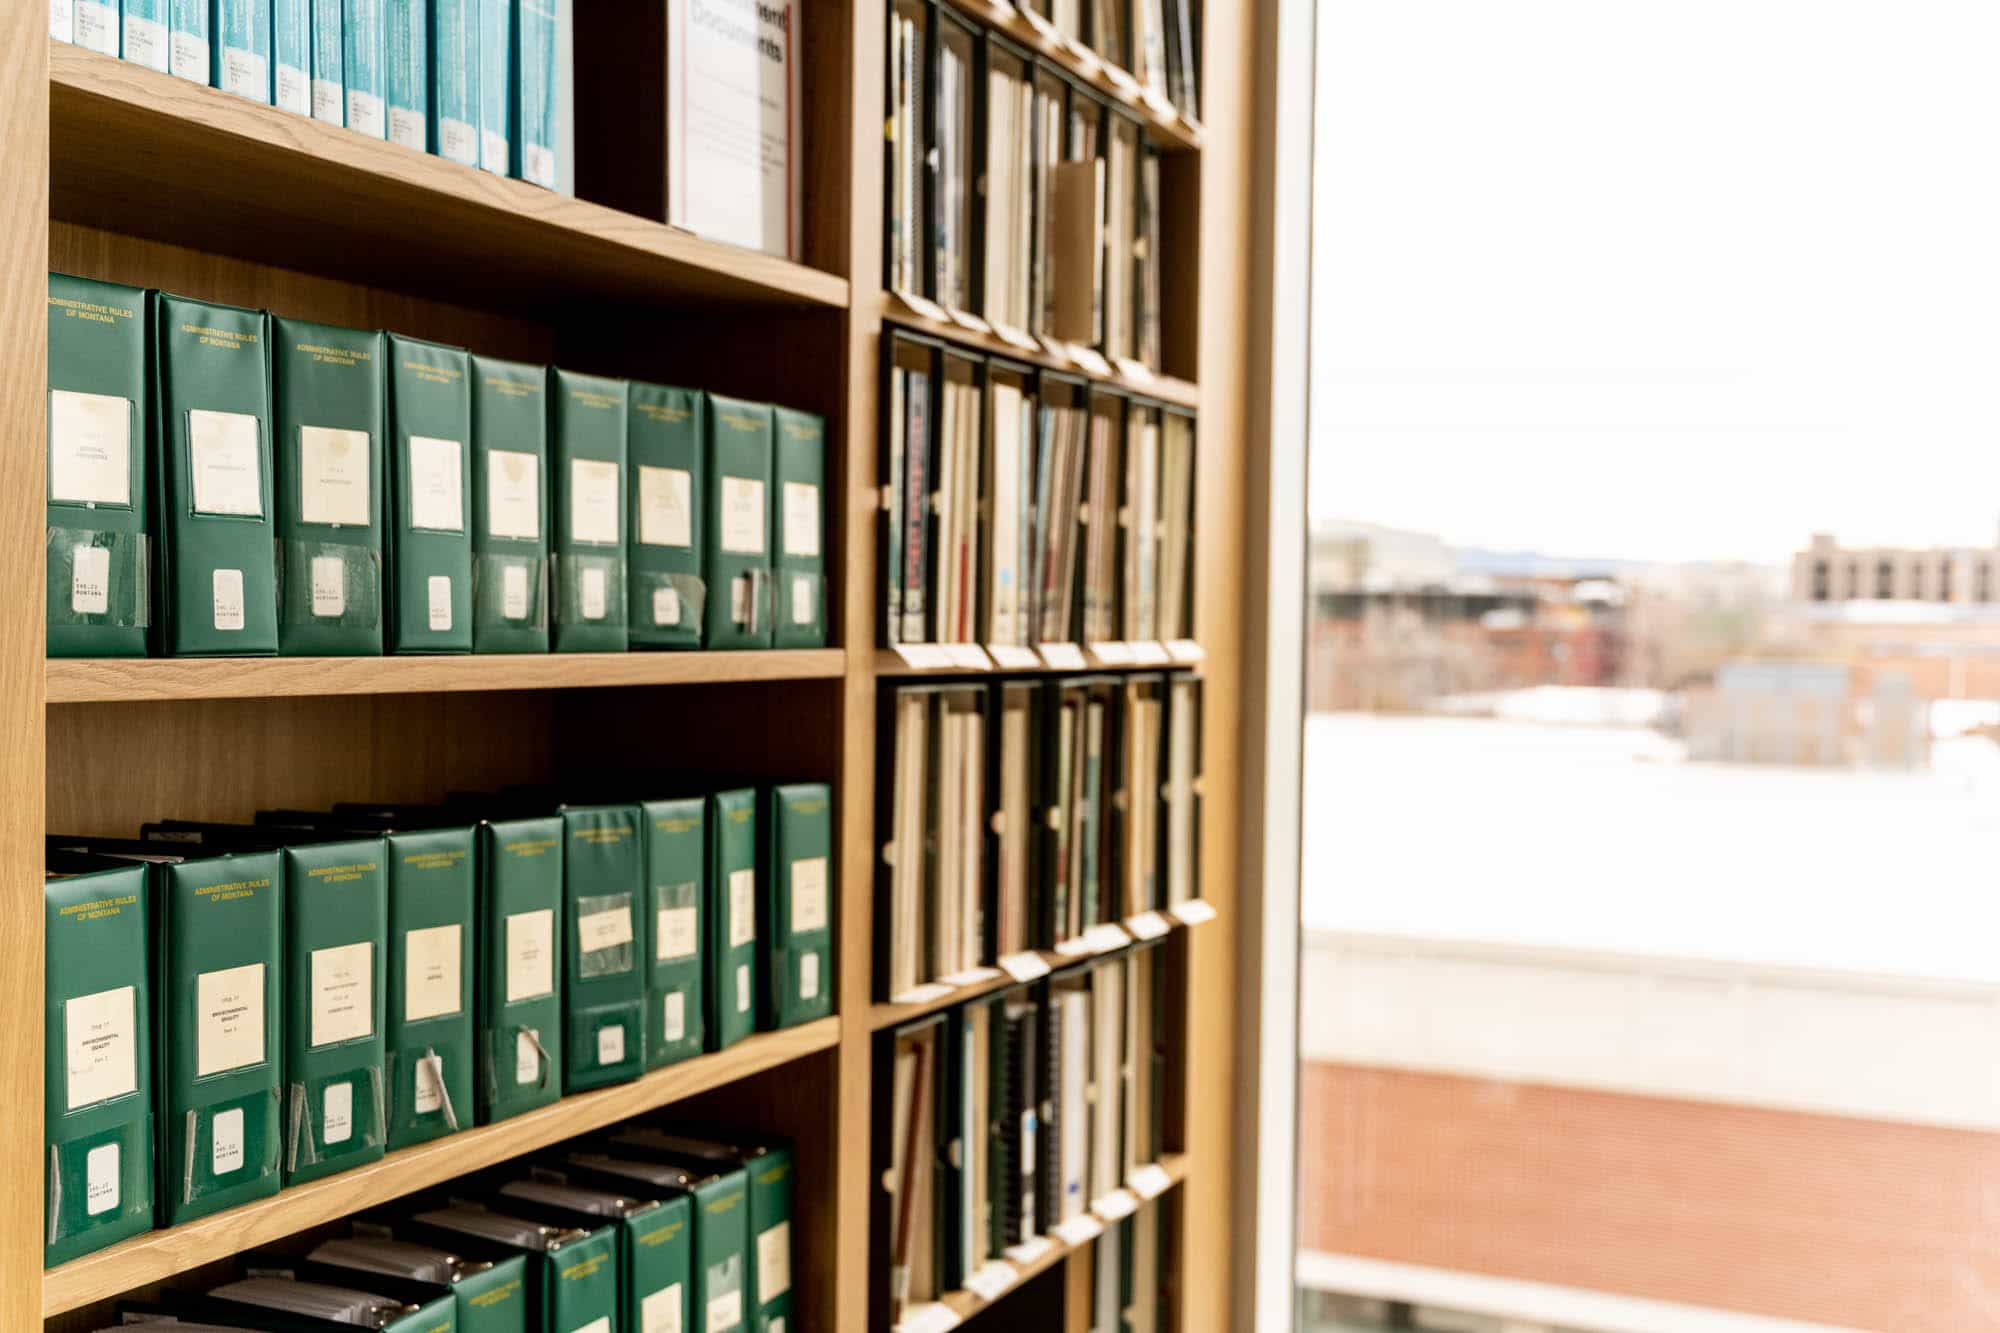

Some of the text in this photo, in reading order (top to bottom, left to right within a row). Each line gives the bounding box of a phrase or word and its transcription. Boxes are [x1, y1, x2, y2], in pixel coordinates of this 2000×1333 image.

[66, 308, 116, 323] OF MONTANA
[109, 306, 134, 318] RULES
[195, 879, 271, 896] ADMINISTRATIVE RULES
[211, 889, 254, 902] OF MONTANA
[60, 895, 137, 916] ADMINISTRATIVE RULES
[77, 907, 121, 921] OF MONTANA
